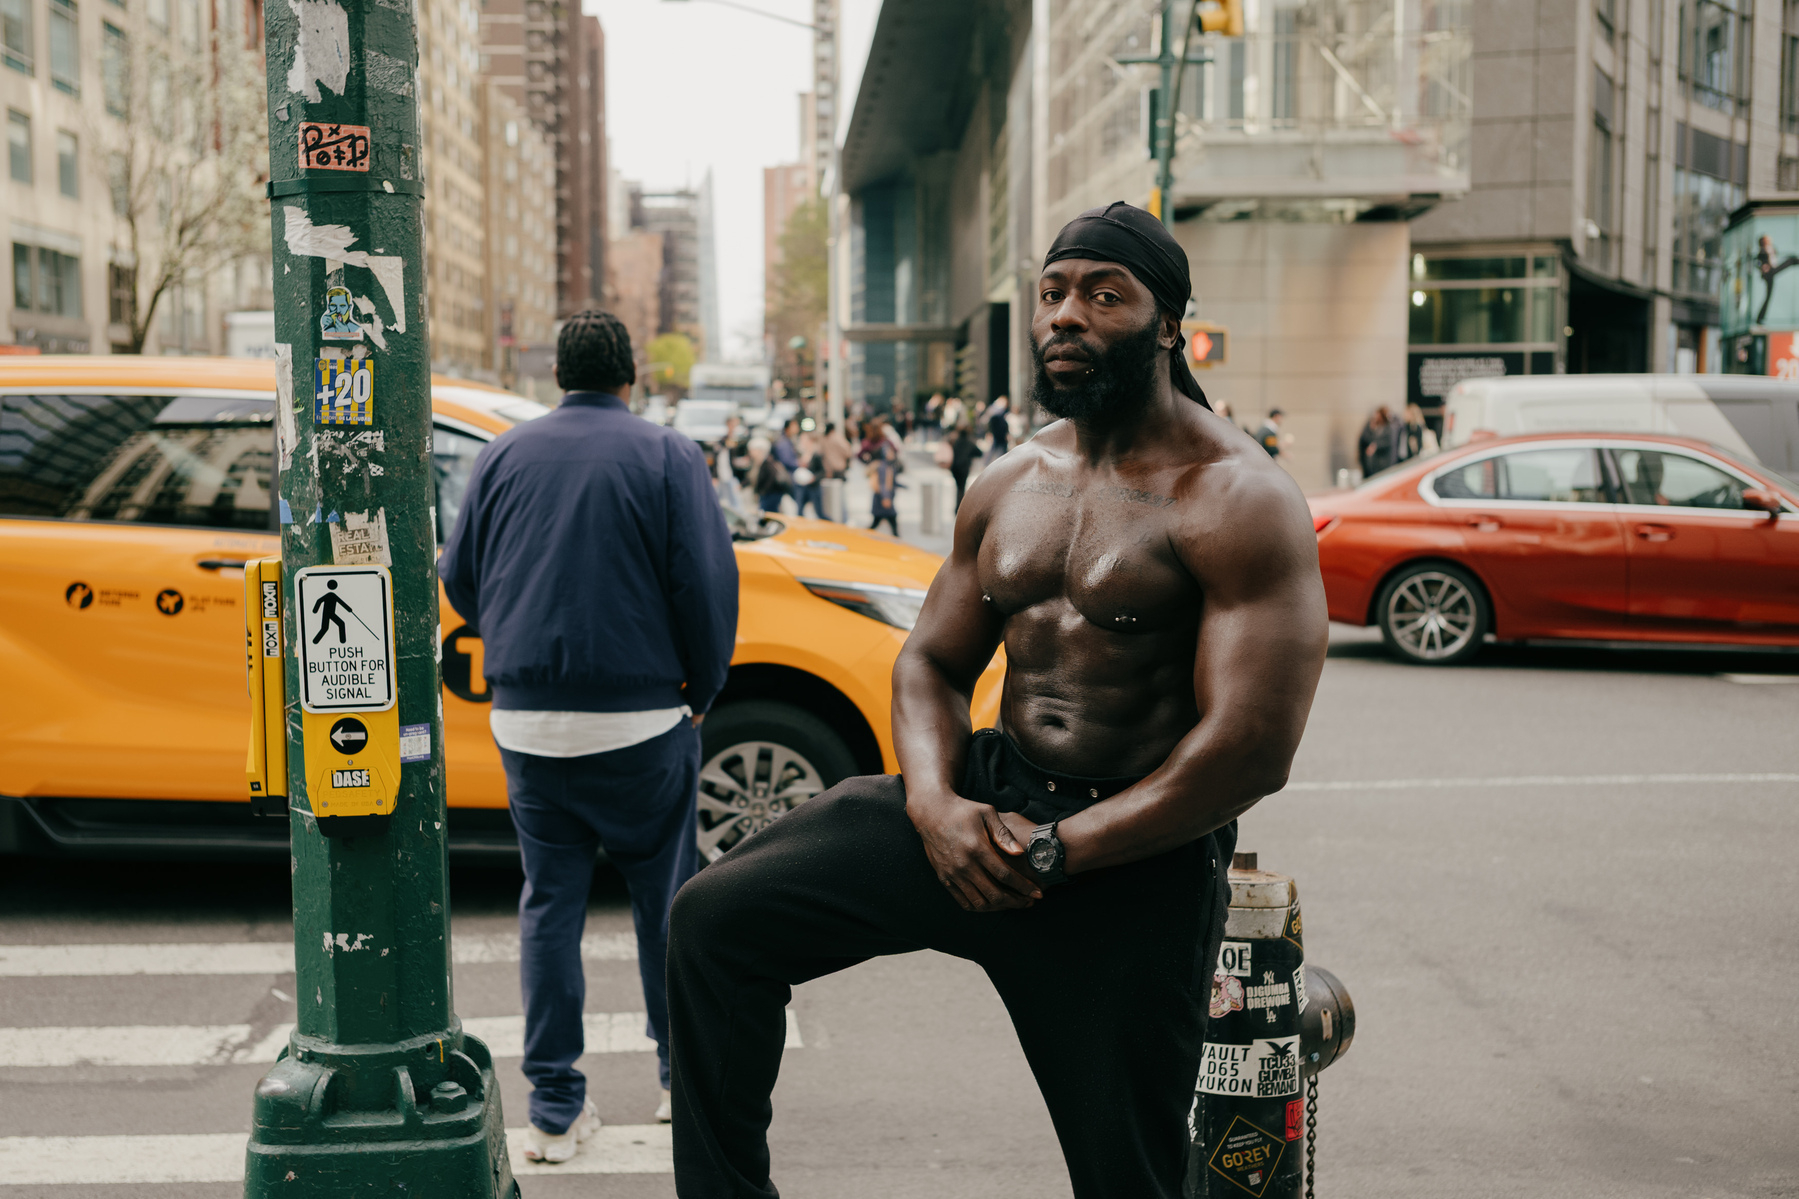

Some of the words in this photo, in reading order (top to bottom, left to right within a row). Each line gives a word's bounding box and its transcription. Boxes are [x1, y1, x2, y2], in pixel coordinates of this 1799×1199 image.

[316, 368, 371, 408] +20
[336, 528, 370, 542] REAL
[329, 646, 363, 659] PUSH
[309, 660, 357, 673] BUTTON
[361, 659, 385, 671] FOR
[321, 673, 375, 686] AUDIBLE
[326, 687, 372, 700] SIGNAL
[333, 770, 370, 788] DASE
[1207, 1061, 1239, 1077] D65
[1258, 1067, 1296, 1083] GUMBA
[1198, 1074, 1252, 1093] YUKON
[1257, 1079, 1297, 1096] REMAND
[1222, 1143, 1271, 1169] GOREY
